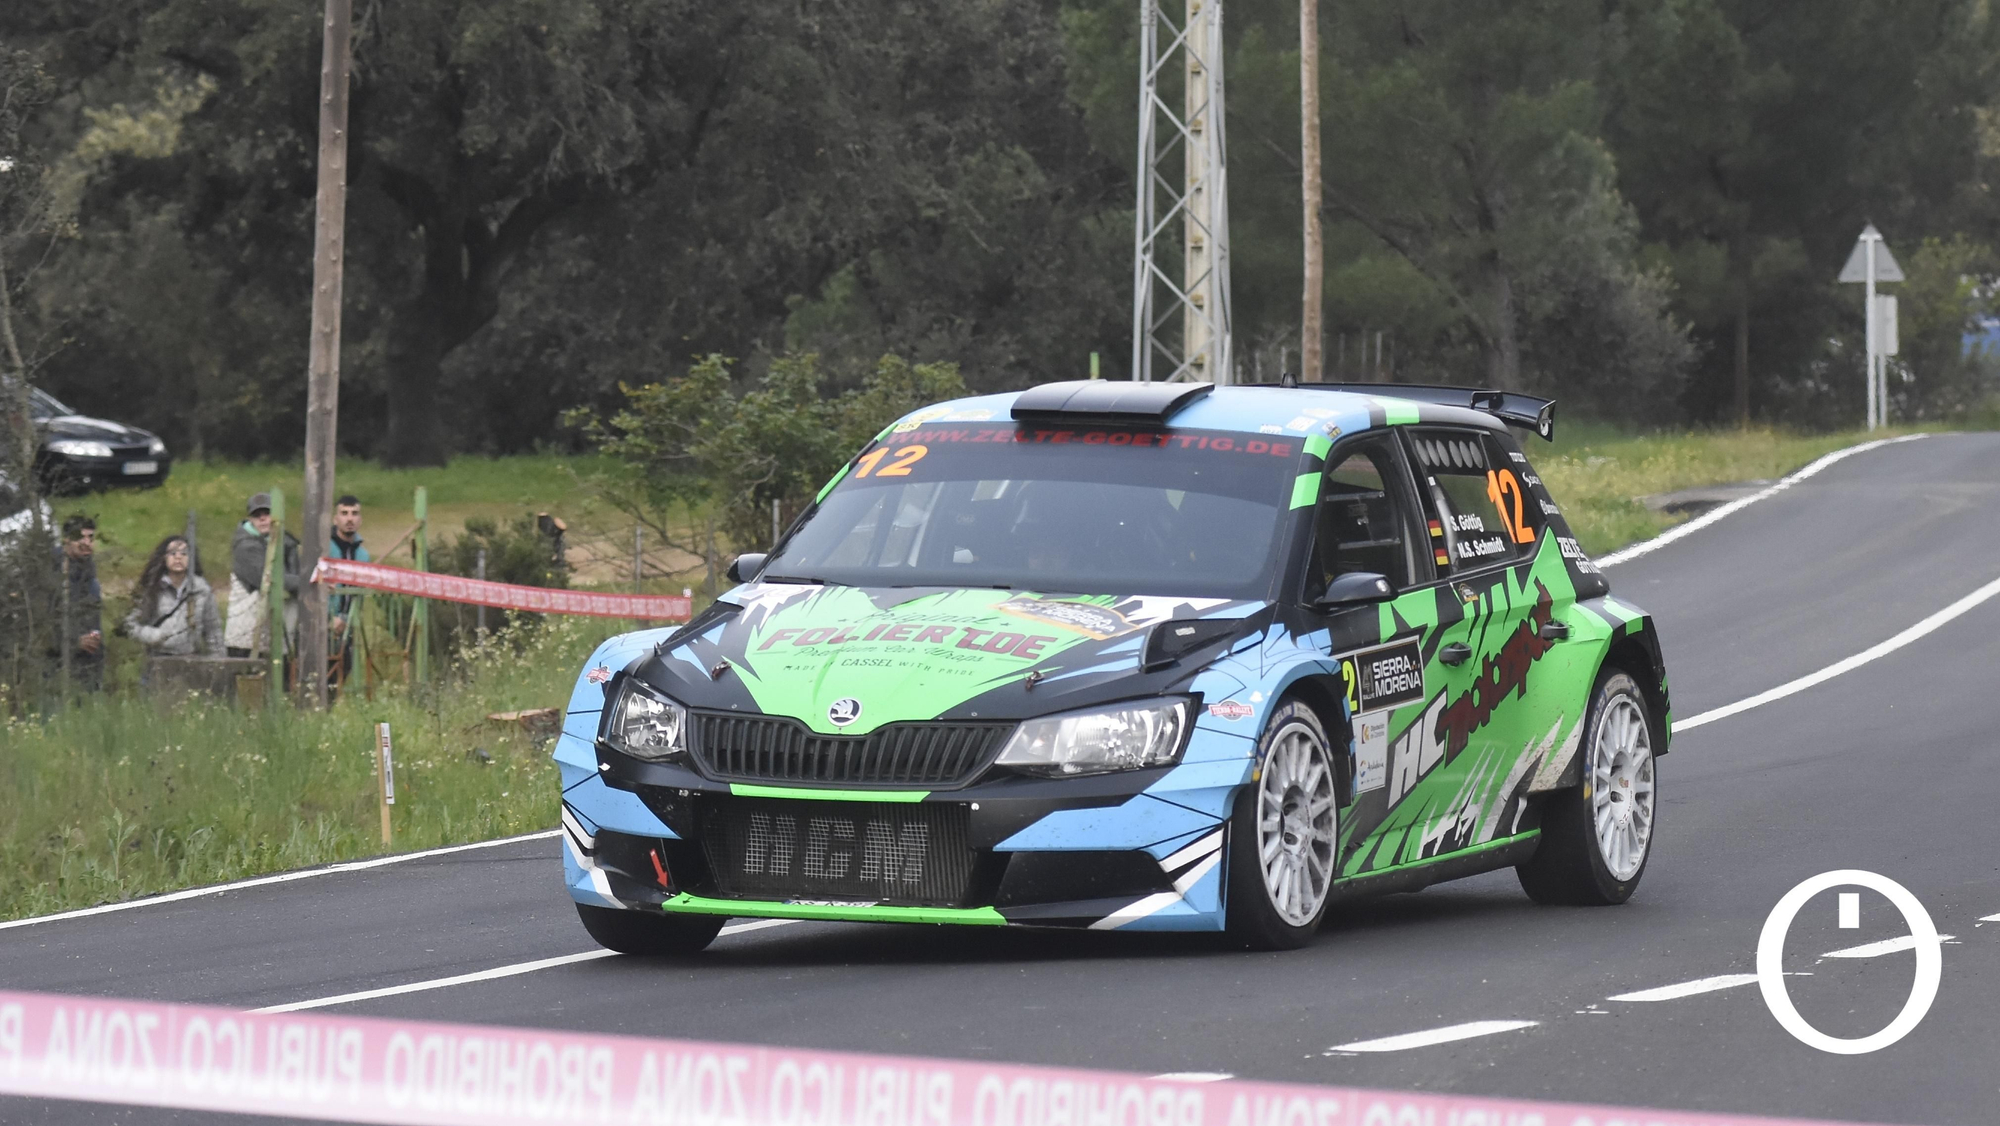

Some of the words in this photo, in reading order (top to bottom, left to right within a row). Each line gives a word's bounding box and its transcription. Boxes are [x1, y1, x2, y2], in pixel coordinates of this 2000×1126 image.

[886, 428, 1293, 458] WWW.ZELTE-GOETTIG.DE
[855, 444, 929, 479] 12
[1486, 468, 1537, 544] 12
[1450, 516, 1459, 532] S.
[1458, 513, 1485, 533] Göttig
[1456, 541, 1475, 559] N.S.
[1474, 536, 1506, 556] Schmidt
[840, 658, 894, 668] CASSEL
[898, 660, 932, 672] WITH
[938, 667, 976, 676] PRIDE
[923, 646, 984, 663] Wraps
[1372, 655, 1412, 680] SIERRA
[1374, 671, 1421, 698] MORENA
[1388, 691, 1447, 809] HC
[743, 811, 929, 885] HGM
